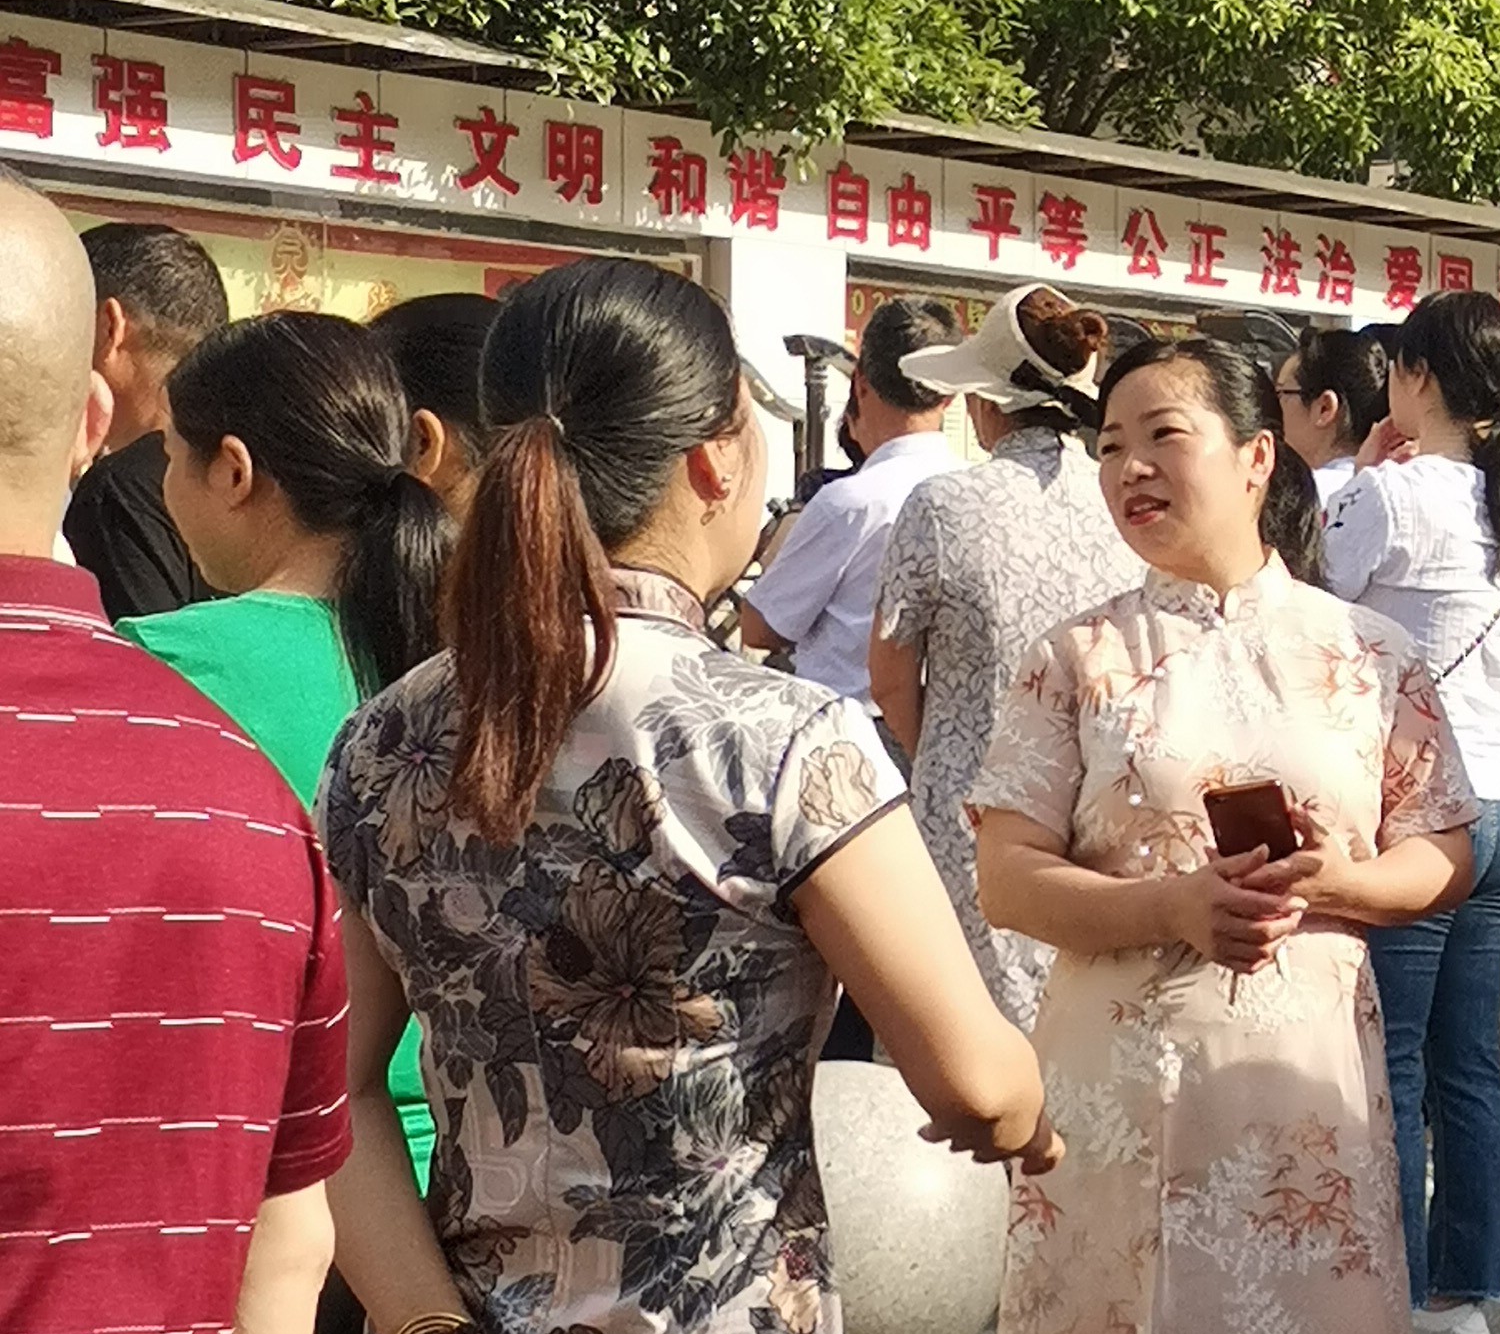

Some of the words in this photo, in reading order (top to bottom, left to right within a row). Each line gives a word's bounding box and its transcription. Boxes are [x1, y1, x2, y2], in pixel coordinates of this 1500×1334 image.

[0, 36, 171, 154] 富强
[232, 73, 401, 183] 民主
[456, 106, 603, 206] 文明
[648, 135, 786, 231] 和谐
[826, 160, 931, 252] 自由
[971, 184, 1088, 270] 平等
[1122, 205, 1227, 288] 公正
[1260, 225, 1355, 306] 法治
[1383, 244, 1473, 310] 爱国
